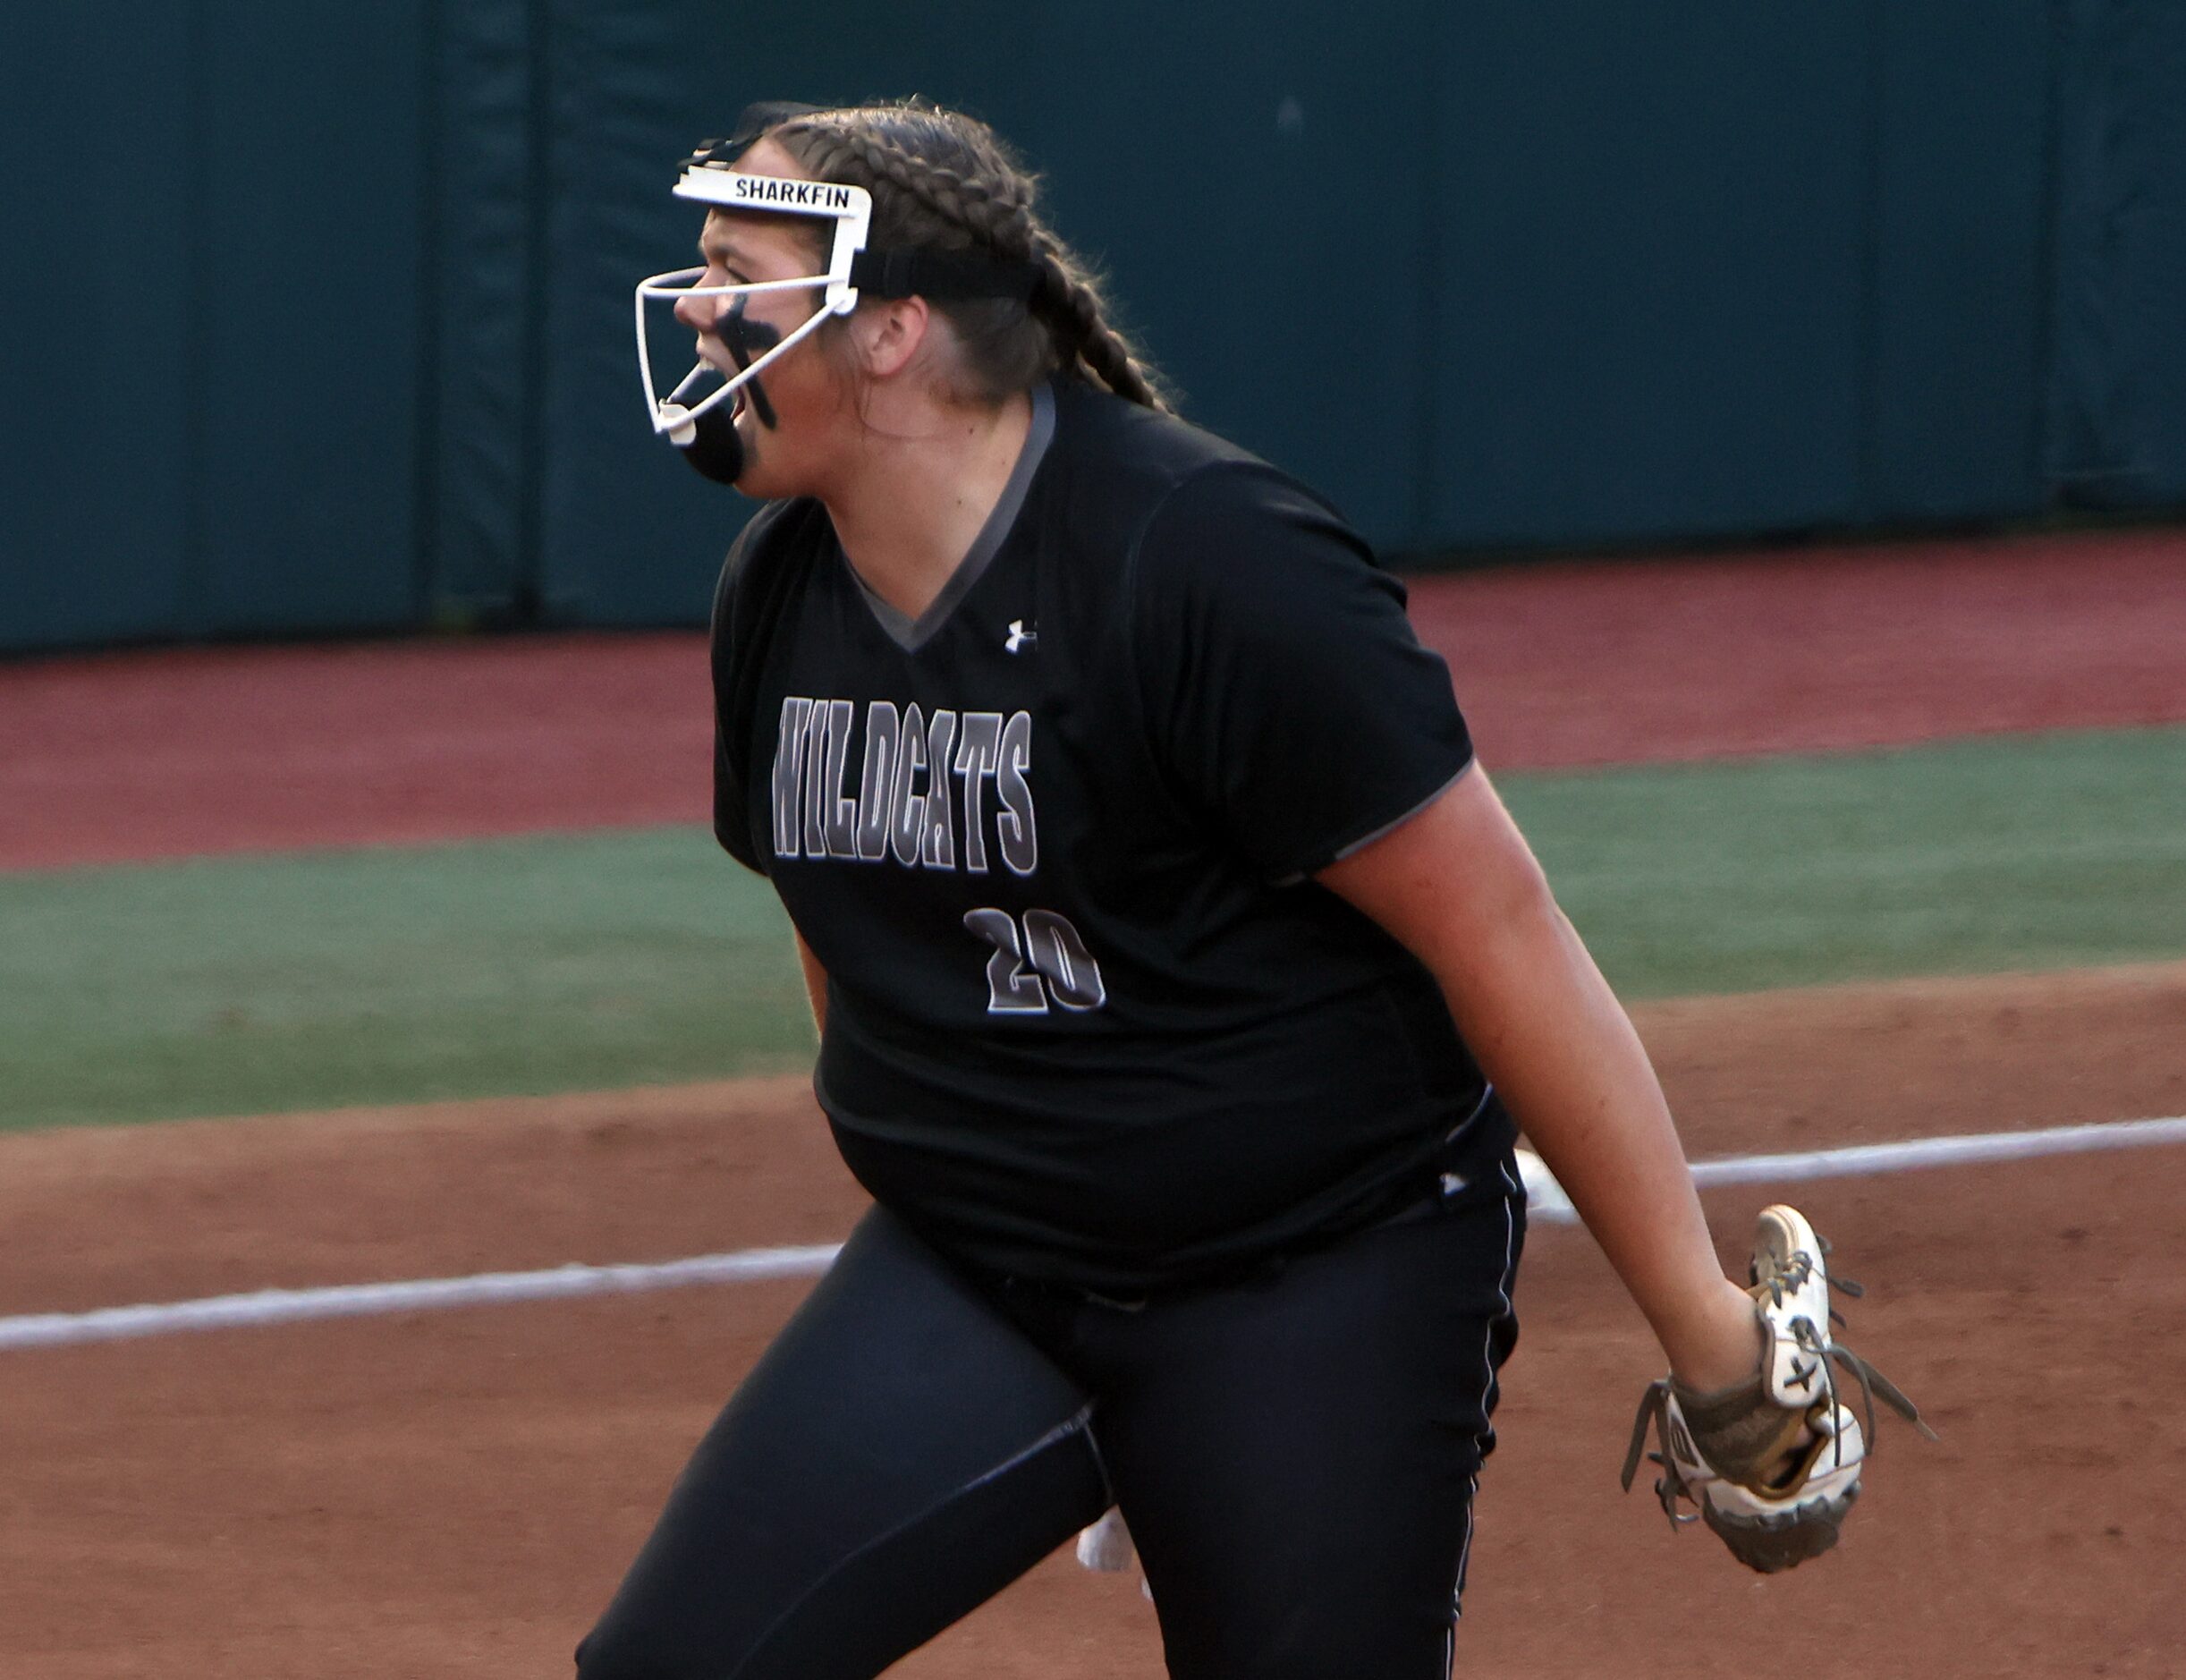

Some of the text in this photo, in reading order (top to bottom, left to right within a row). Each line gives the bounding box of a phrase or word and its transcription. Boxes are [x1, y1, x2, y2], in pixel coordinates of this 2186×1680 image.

[736, 178, 850, 208] SHARKFIN
[772, 696, 1038, 876] WILDCATS
[963, 907, 1106, 1014] 20
